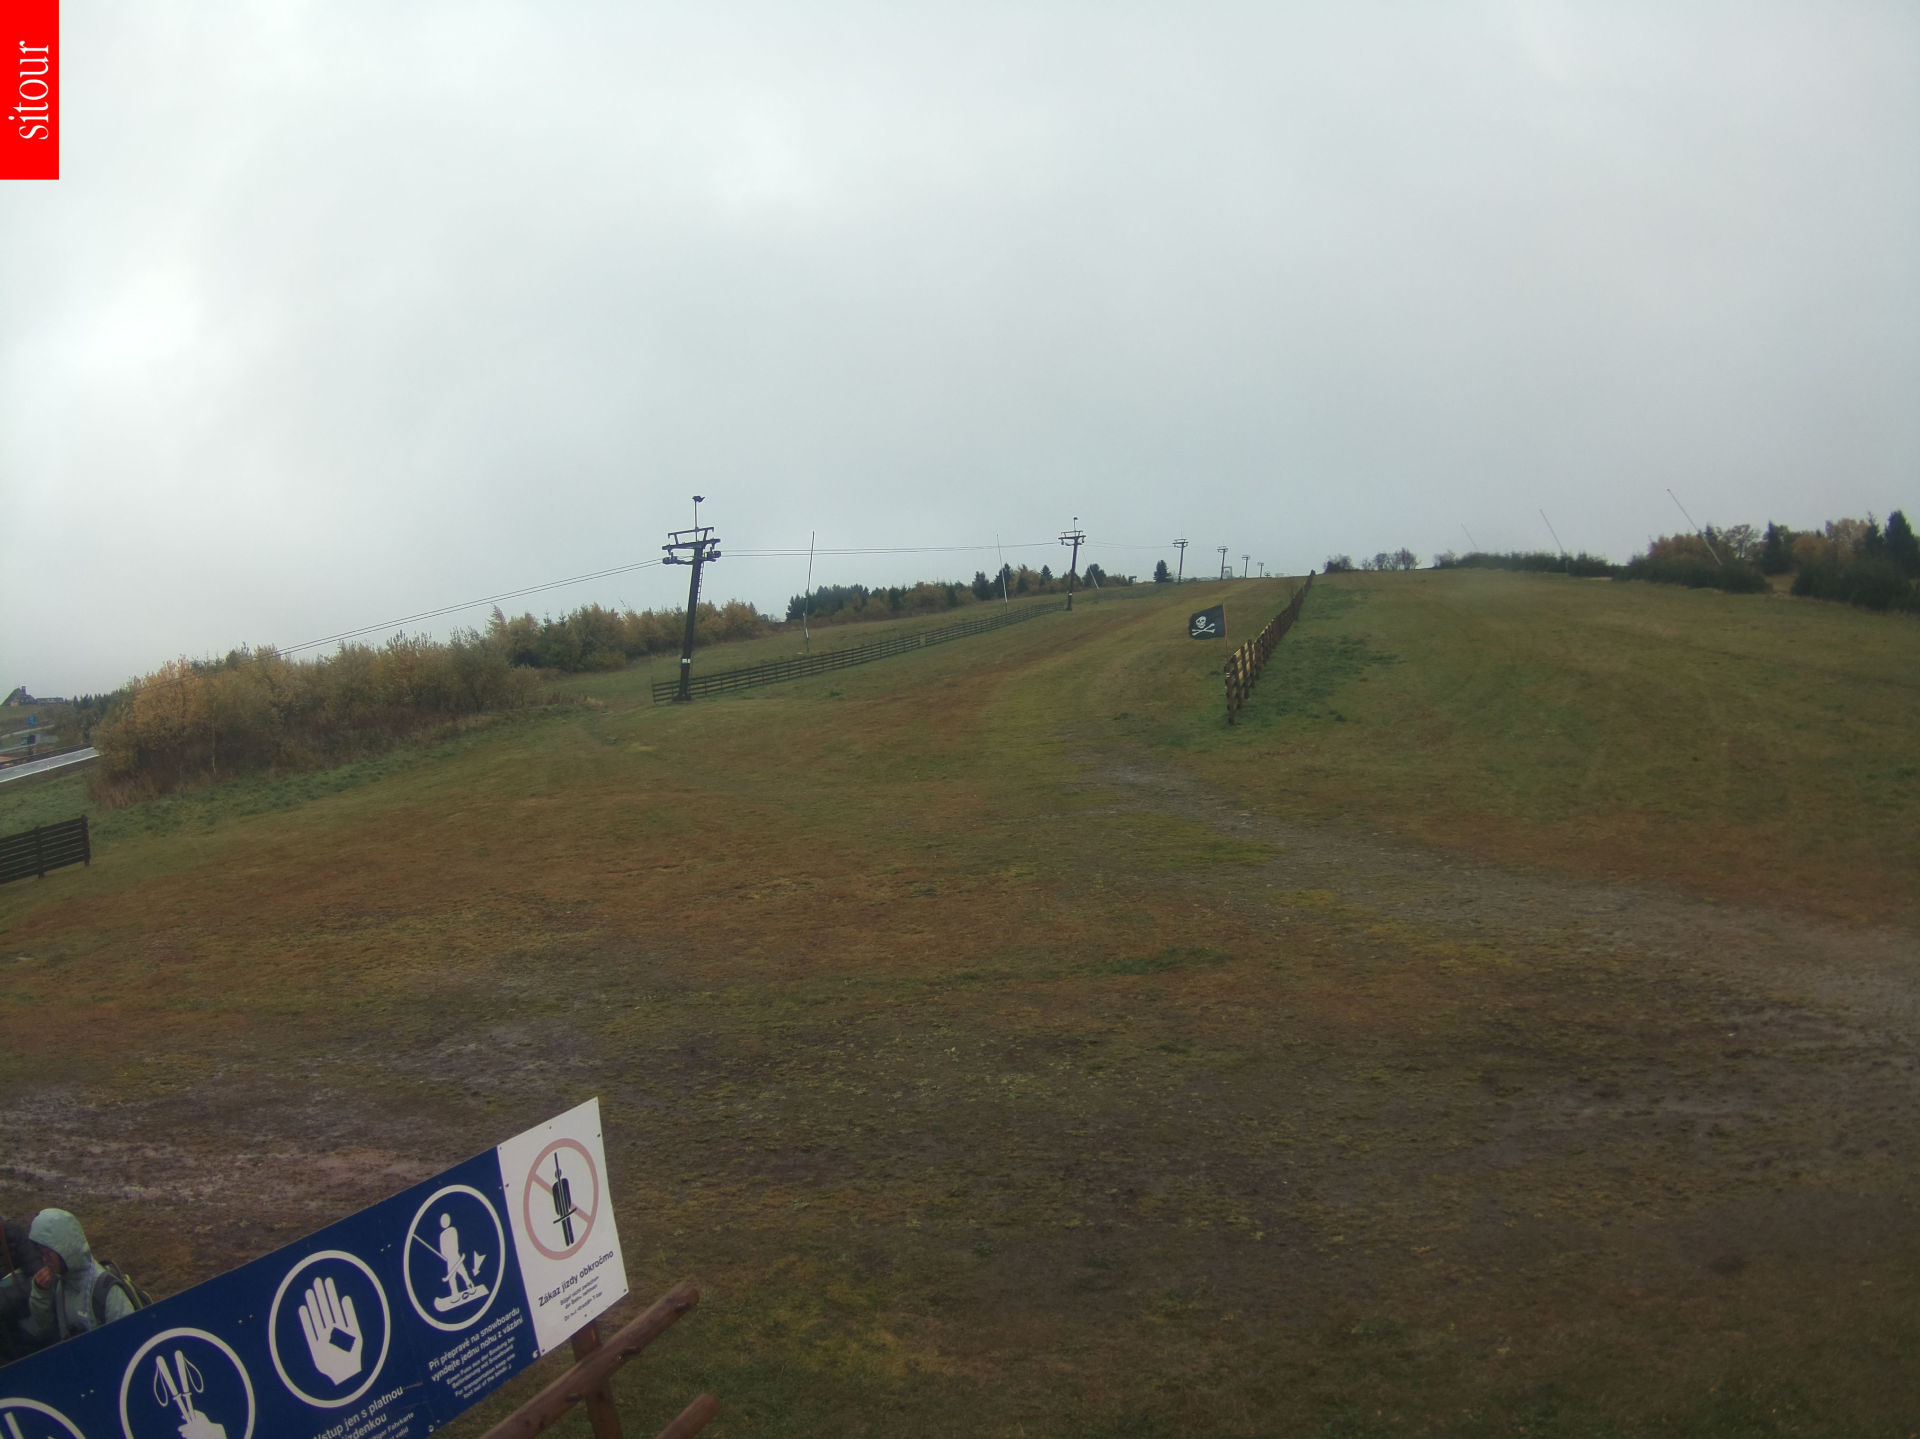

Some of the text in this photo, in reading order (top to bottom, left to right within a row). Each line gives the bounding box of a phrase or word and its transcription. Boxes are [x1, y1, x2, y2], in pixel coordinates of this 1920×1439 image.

[538, 1286, 561, 1307] Zákaz
[561, 1274, 578, 1293] jízdy
[579, 1250, 614, 1278] obkročmo
[428, 1307, 520, 1371] Při přepravě na snowboardu
[431, 1360, 461, 1382] vyndejte
[461, 1346, 480, 1365] jednu
[480, 1334, 497, 1350] nohu
[502, 1315, 524, 1334] vázání
[344, 1413, 360, 1431] jen
[360, 1408, 368, 1418] s
[368, 1386, 404, 1416] platnou
